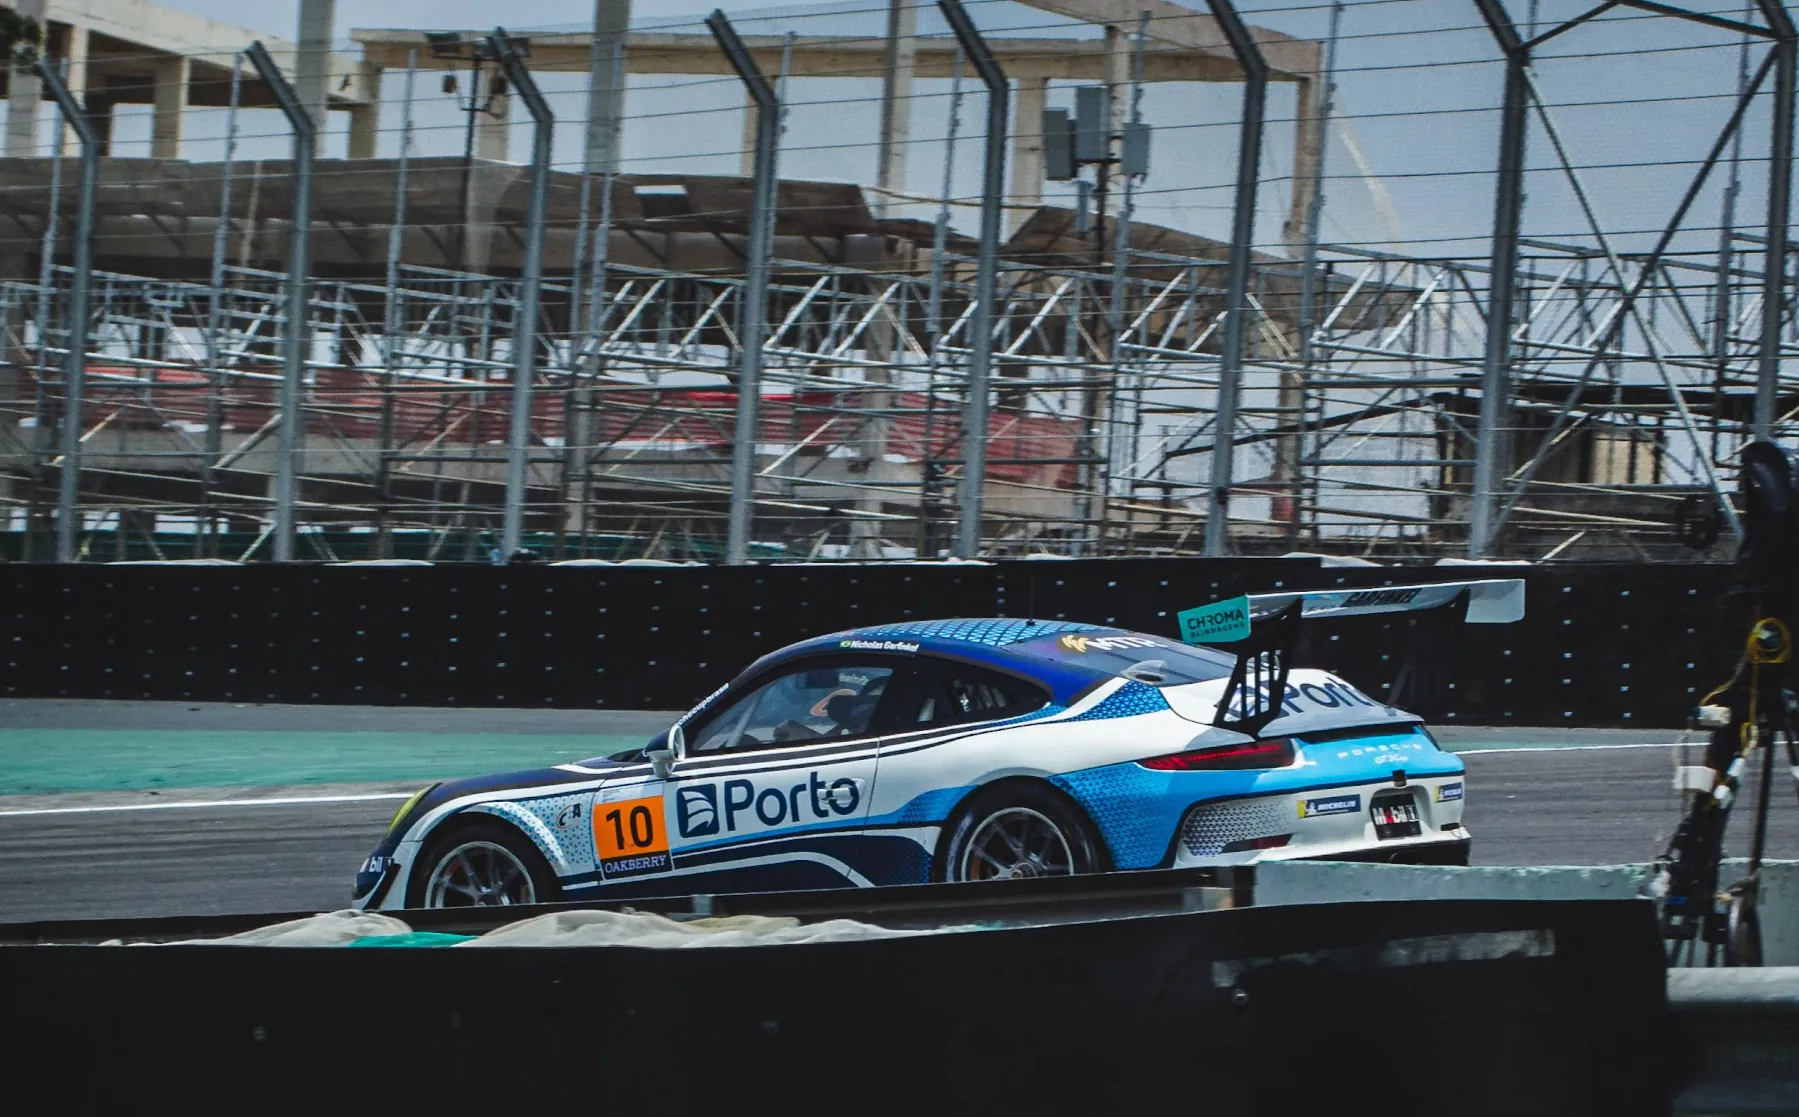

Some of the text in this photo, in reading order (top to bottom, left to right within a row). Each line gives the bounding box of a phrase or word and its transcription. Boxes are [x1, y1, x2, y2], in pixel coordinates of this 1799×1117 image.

[1188, 608, 1245, 630] CHROMA
[850, 640, 920, 652] Nicholas Garfinkel
[1282, 676, 1374, 713] Port
[724, 771, 859, 831] Porto
[1317, 800, 1357, 810] MICHELIN
[1372, 805, 1407, 826] Mobil
[606, 805, 653, 850] 10
[605, 855, 666, 873] OAKBERRY
